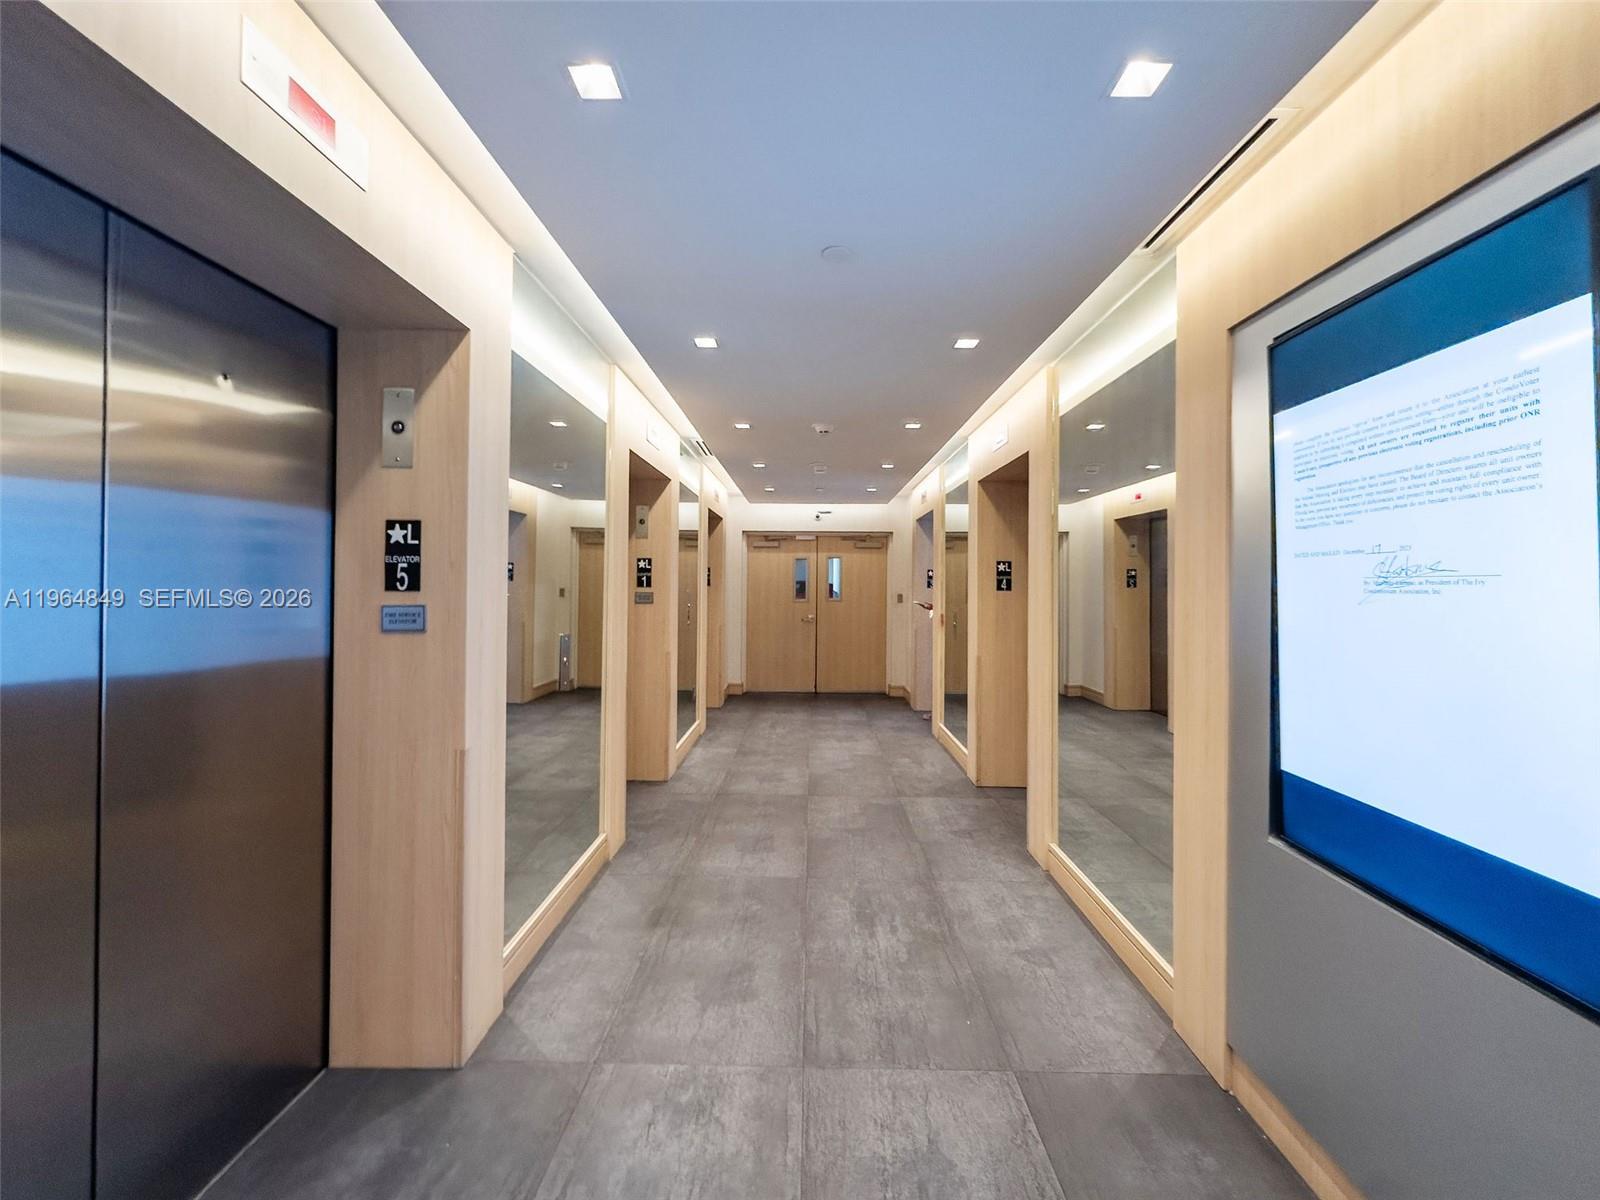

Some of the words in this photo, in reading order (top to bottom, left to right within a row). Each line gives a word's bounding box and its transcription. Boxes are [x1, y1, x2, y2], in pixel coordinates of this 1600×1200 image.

[1523, 399, 1540, 407] with
[385, 555, 420, 564] ELEVATOR
[396, 563, 409, 591] 5
[641, 575, 647, 588] 1
[1001, 577, 1008, 591] 4
